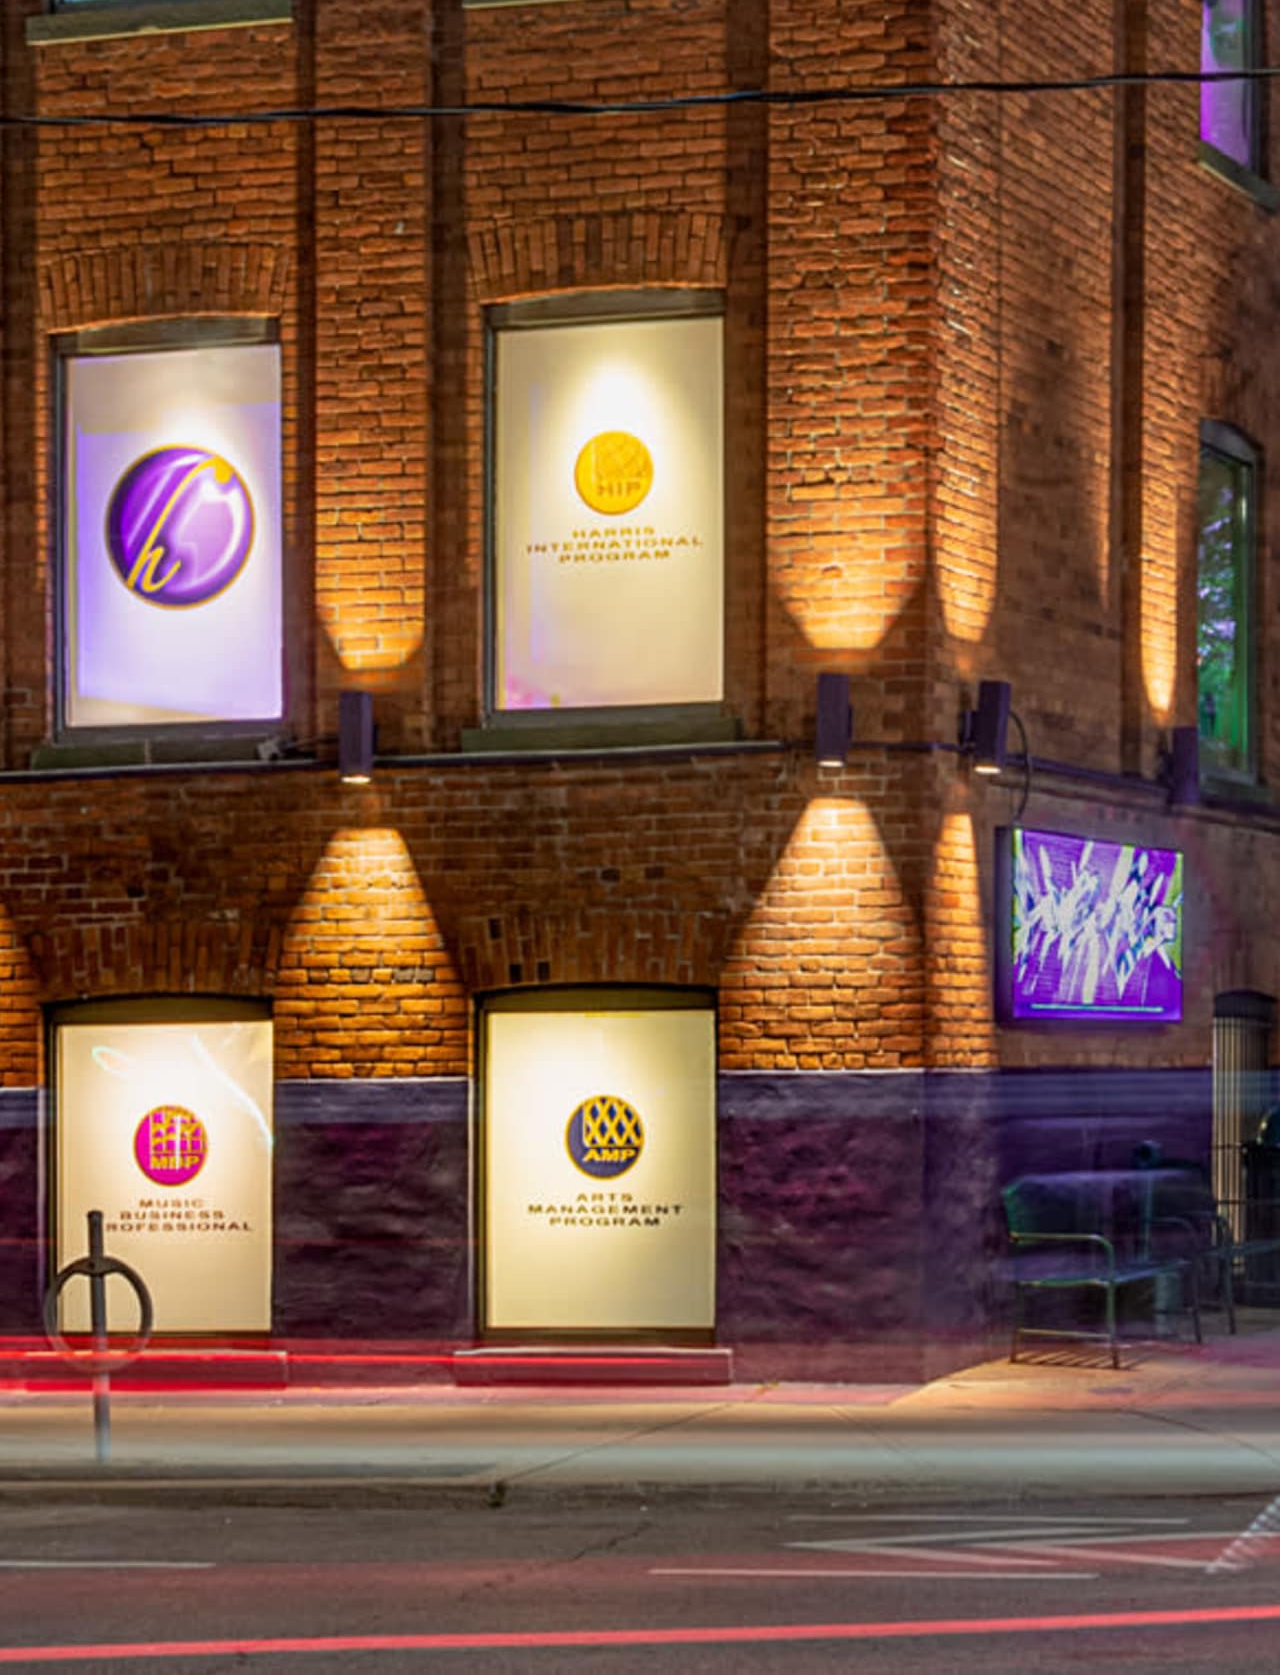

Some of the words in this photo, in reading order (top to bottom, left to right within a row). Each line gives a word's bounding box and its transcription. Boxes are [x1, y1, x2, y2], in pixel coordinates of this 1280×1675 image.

[572, 526, 656, 539] HARRIS
[526, 536, 704, 555] INTERNATIONAL
[559, 549, 670, 563] PROGRAM
[583, 1149, 635, 1162] AMP
[576, 1192, 634, 1203] ARTS
[139, 1198, 204, 1209] MUSIC
[528, 1204, 684, 1215] MANAGEMENT
[120, 1210, 225, 1221] BUSINESS
[106, 1221, 253, 1233] ROFESSIONAL
[549, 1217, 660, 1227] PROGRAM
